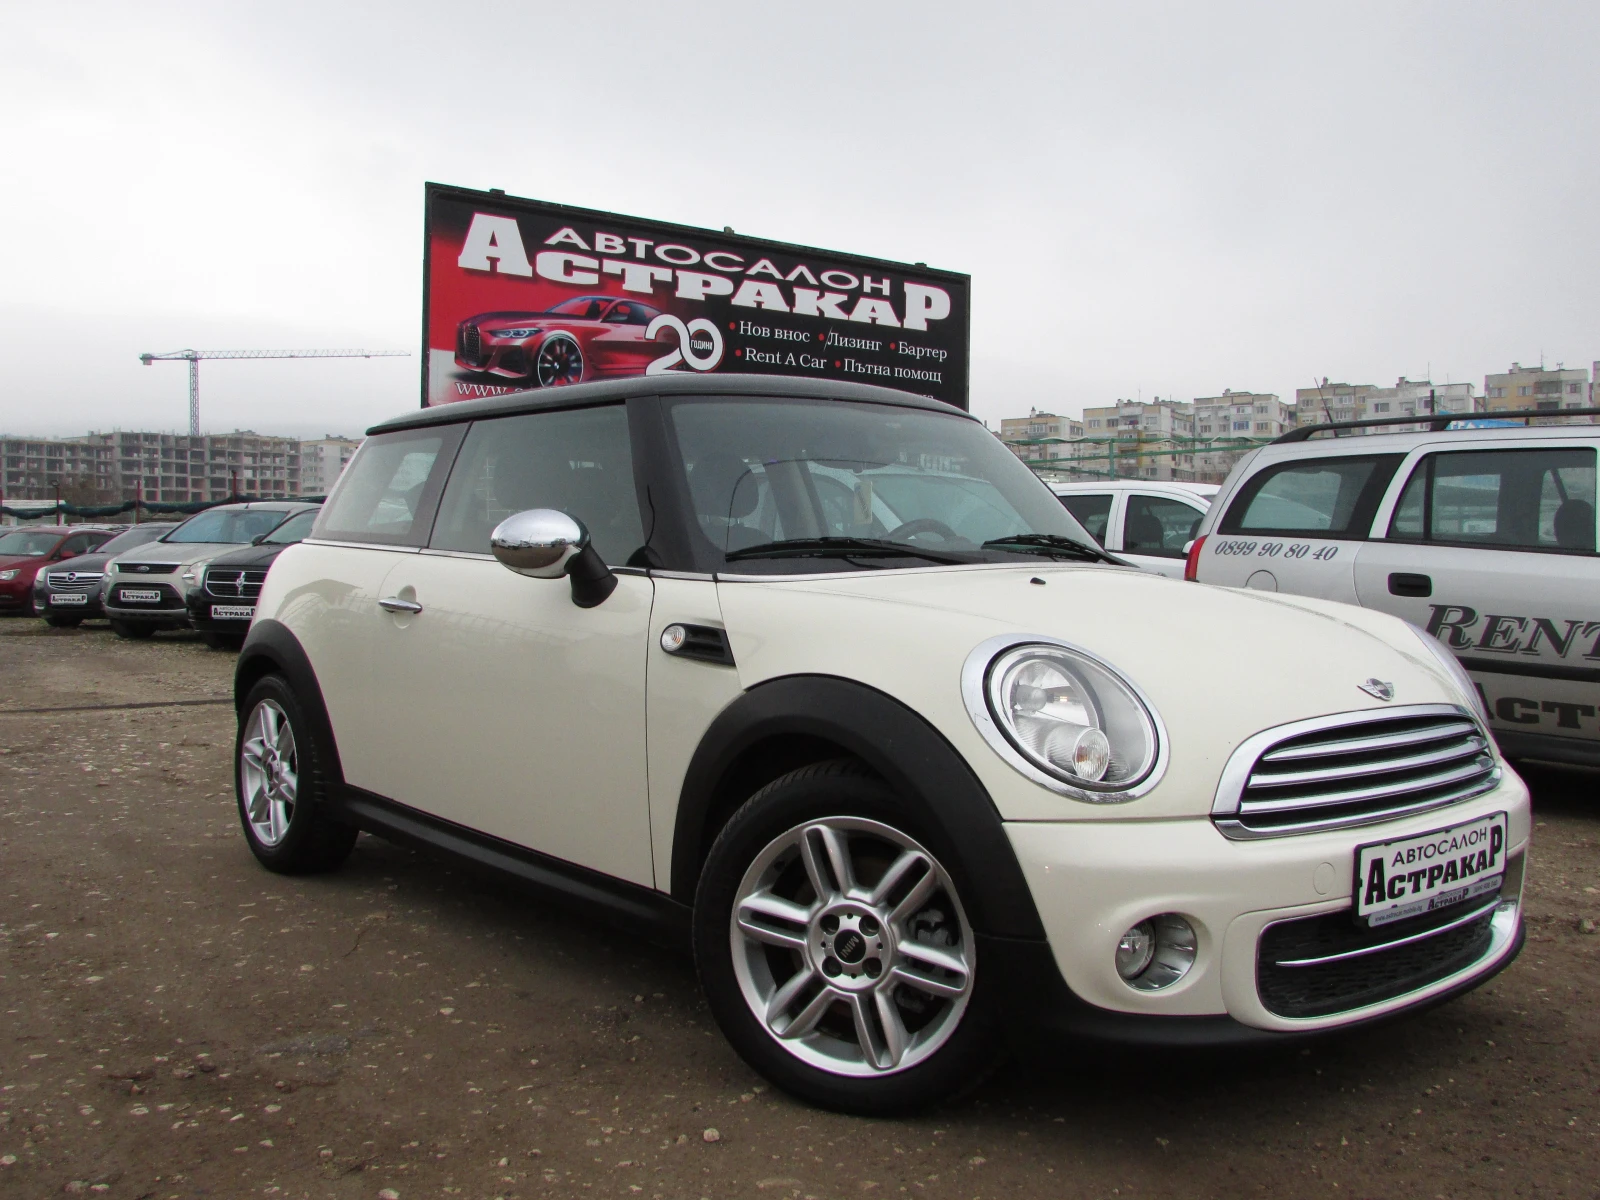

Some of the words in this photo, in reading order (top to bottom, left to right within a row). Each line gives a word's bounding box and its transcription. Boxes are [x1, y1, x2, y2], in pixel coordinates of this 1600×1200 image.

[457, 212, 951, 332] АСТРАКАР
[544, 227, 891, 296] АВТОСАЛОН
[645, 313, 724, 376] 20
[739, 320, 771, 338] Нов
[774, 328, 811, 343] внос
[827, 331, 882, 351] Лизинг
[745, 347, 782, 365] Rent
[785, 353, 797, 366] A
[799, 354, 827, 370] Car
[898, 341, 948, 362] Бартер
[844, 358, 891, 377] Пътна
[894, 368, 942, 384] помощ
[1215, 540, 1257, 556] 0899
[1258, 542, 1283, 557] 90
[1284, 543, 1310, 559] 80
[1312, 545, 1339, 561] 40
[1391, 827, 1487, 867] АВТОСАЛОН
[1364, 824, 1503, 906] АСТРАКАР
